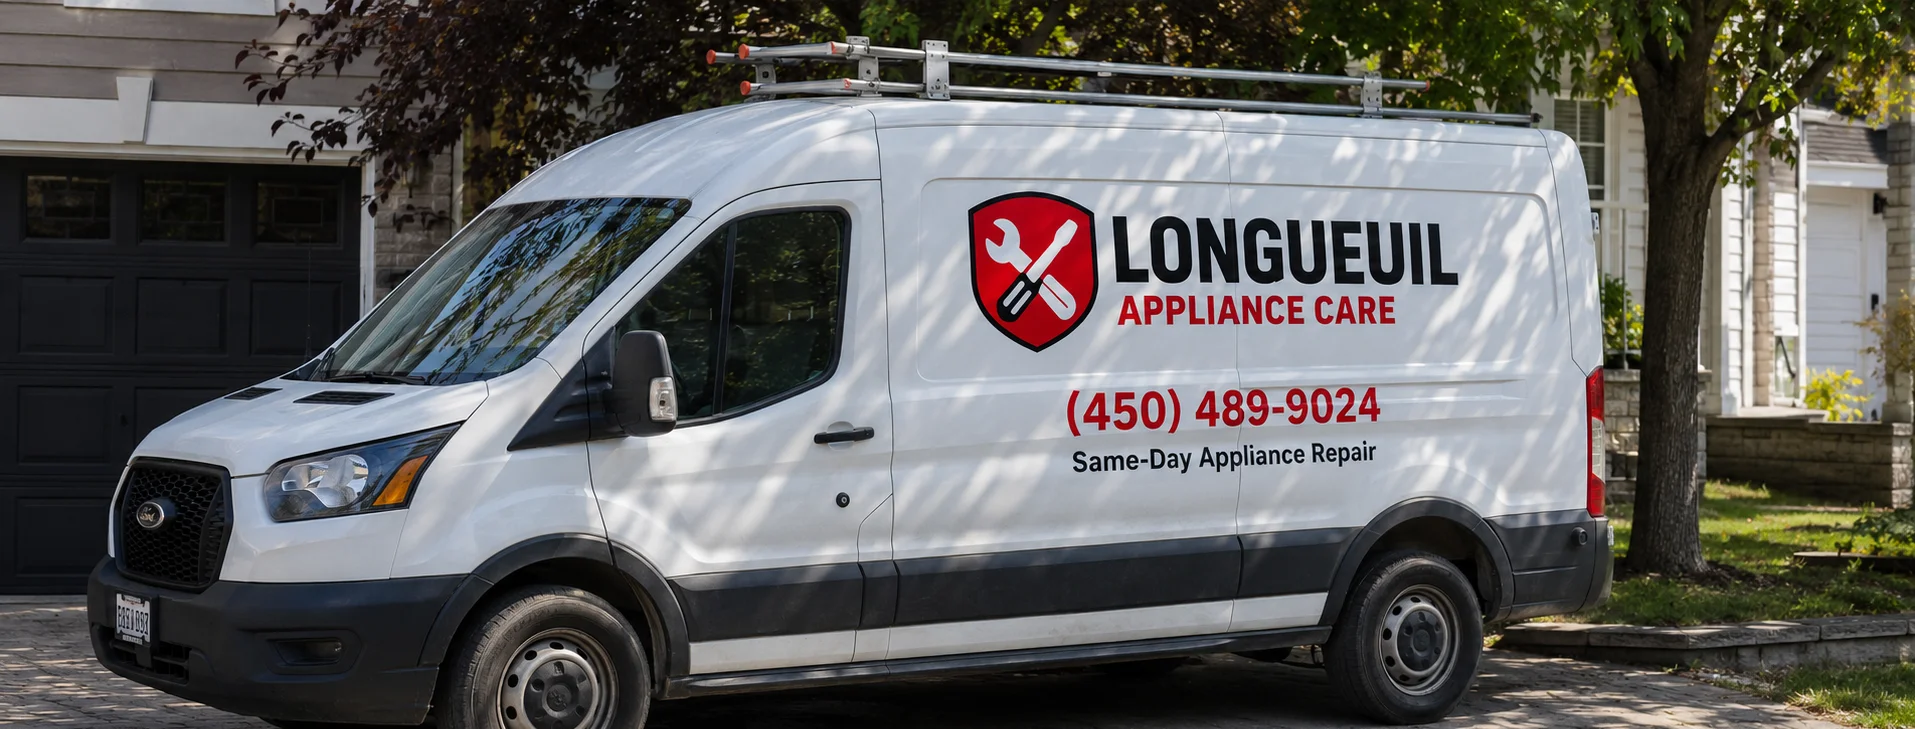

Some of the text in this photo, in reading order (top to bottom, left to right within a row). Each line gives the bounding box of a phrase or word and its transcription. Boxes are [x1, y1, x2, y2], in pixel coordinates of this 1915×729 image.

[1113, 215, 1459, 286] LONGUEUIL
[1118, 295, 1396, 326] APPLIANCE CARE
[1067, 386, 1381, 437] (450) 489-9024
[1072, 440, 1377, 475] Same-Day Appliance Repair
